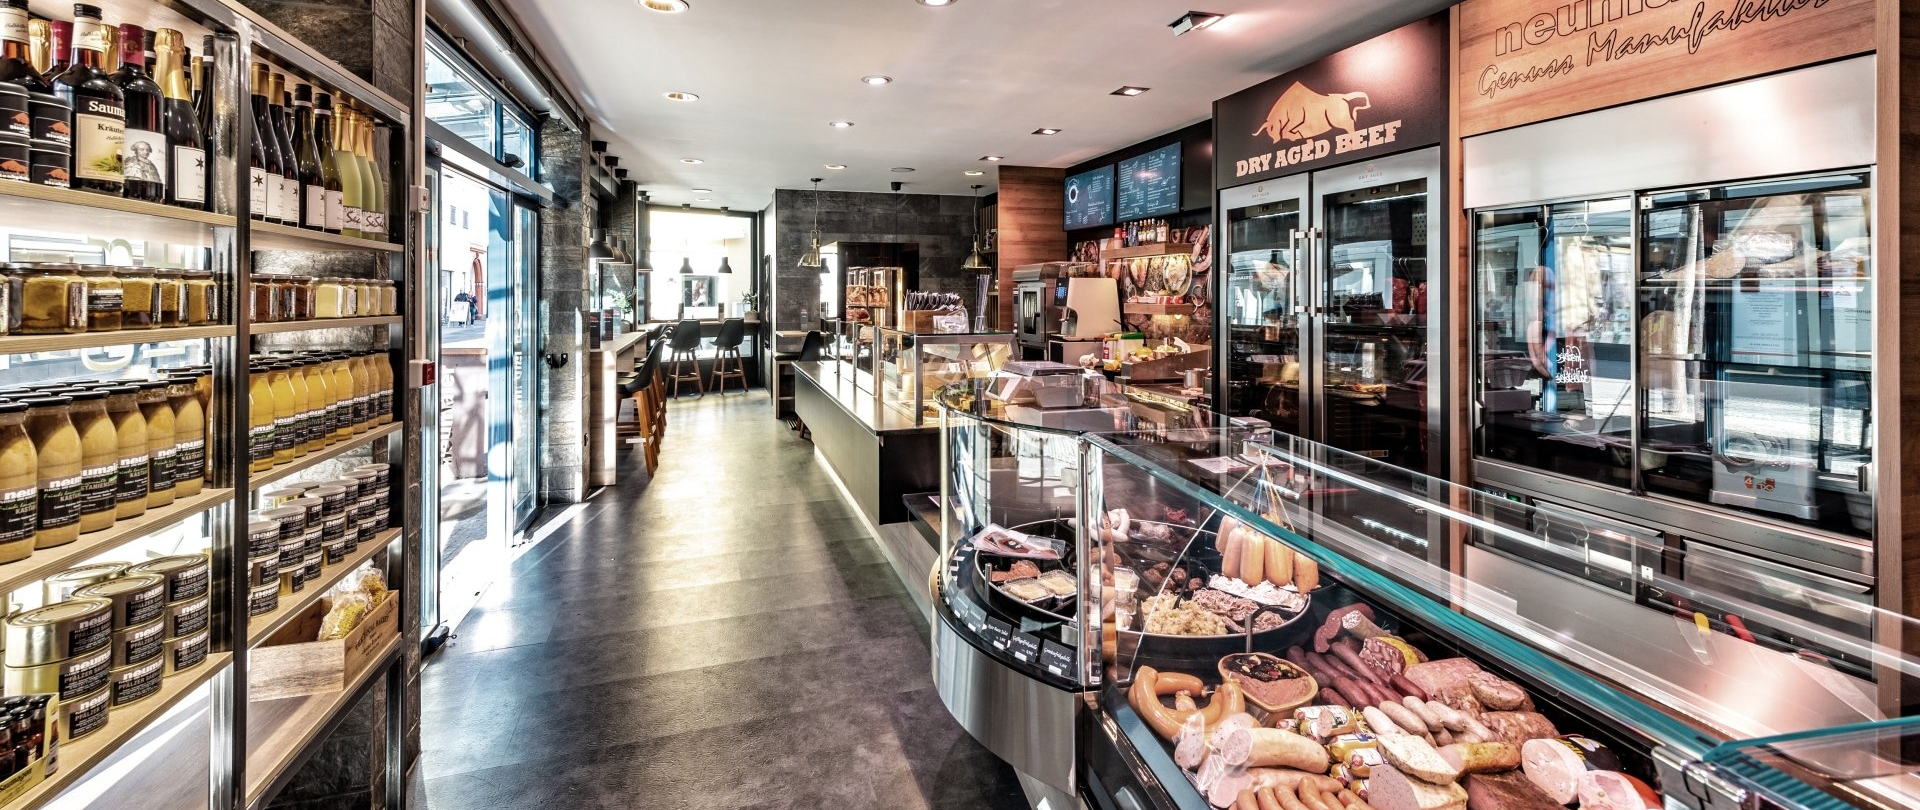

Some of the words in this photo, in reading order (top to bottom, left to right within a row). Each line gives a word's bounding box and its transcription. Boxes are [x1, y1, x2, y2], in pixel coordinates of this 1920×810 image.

[1478, 54, 1575, 99] Genuss
[1236, 152, 1272, 178] DRY
[1274, 138, 1331, 169] AGED
[1335, 119, 1402, 155] BEEF
